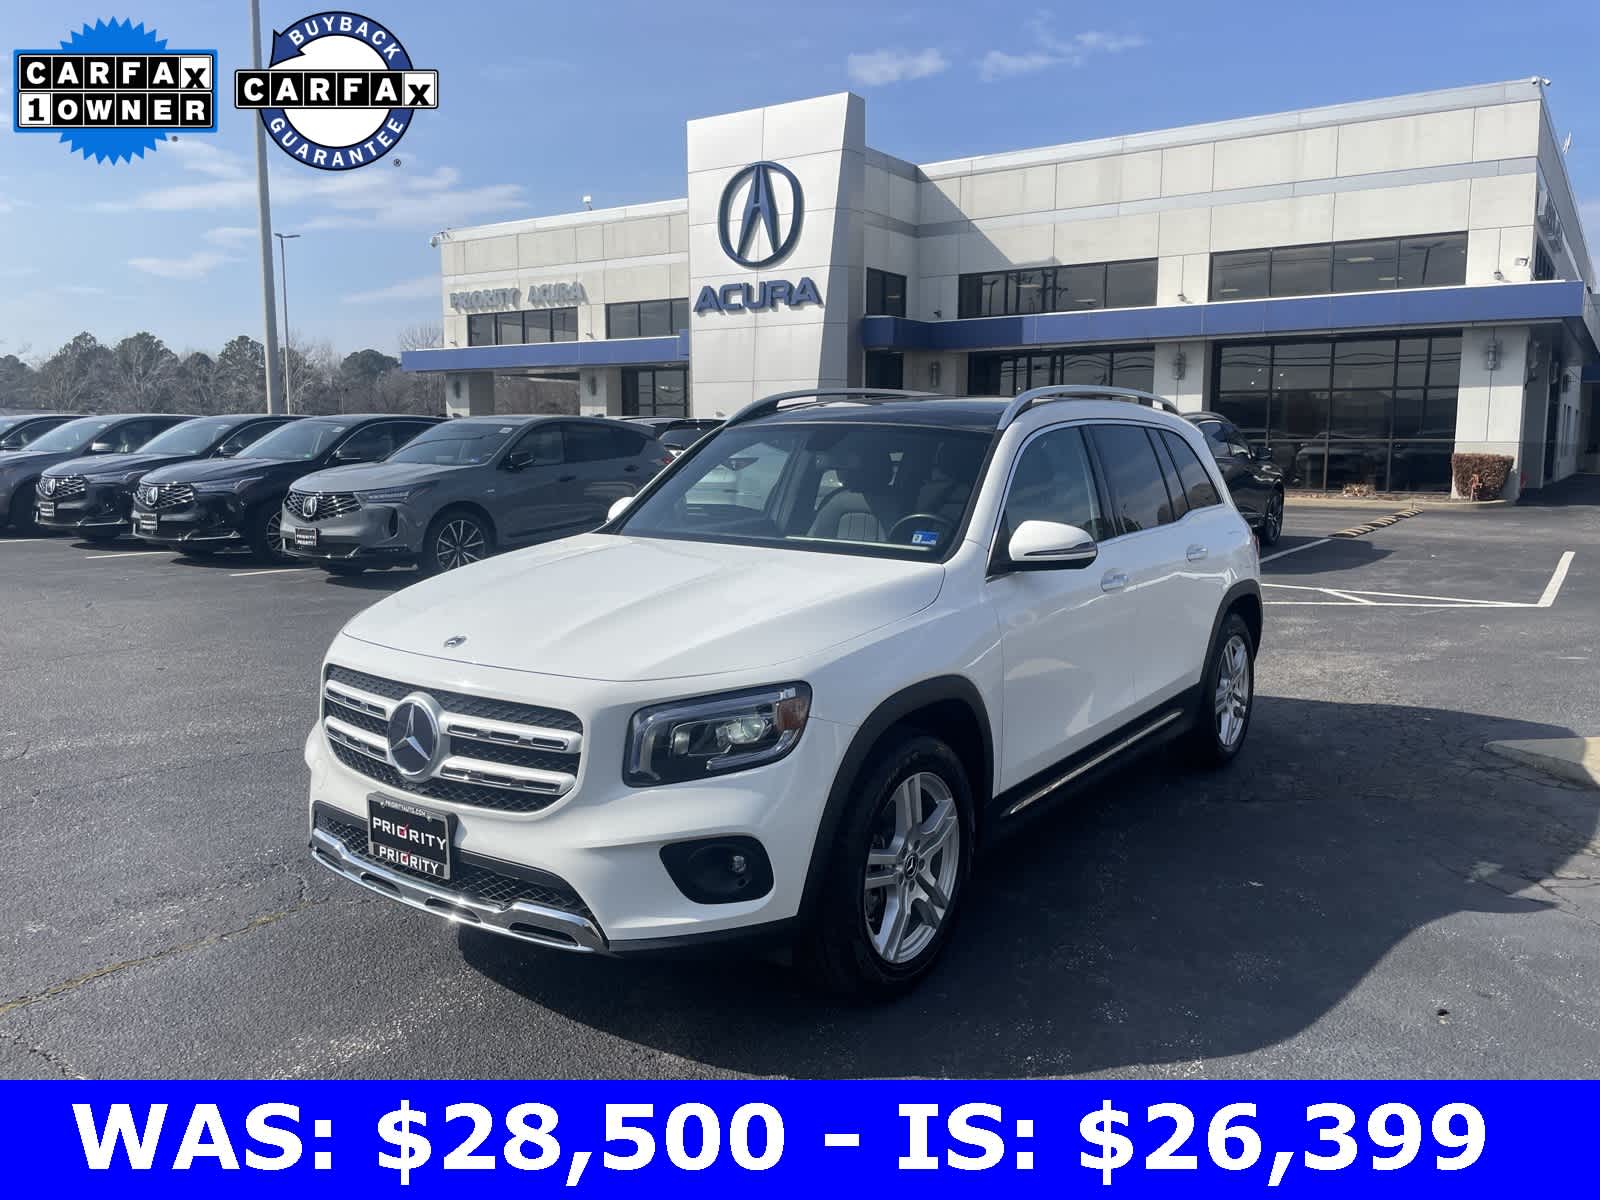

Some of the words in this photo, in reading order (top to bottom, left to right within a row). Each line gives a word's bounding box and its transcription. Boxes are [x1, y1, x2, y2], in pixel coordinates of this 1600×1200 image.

[528, 281, 588, 306] ACURA
[693, 277, 824, 315] ACURA
[373, 816, 446, 850] PRIORITY
[379, 845, 438, 874] PRIORITY
